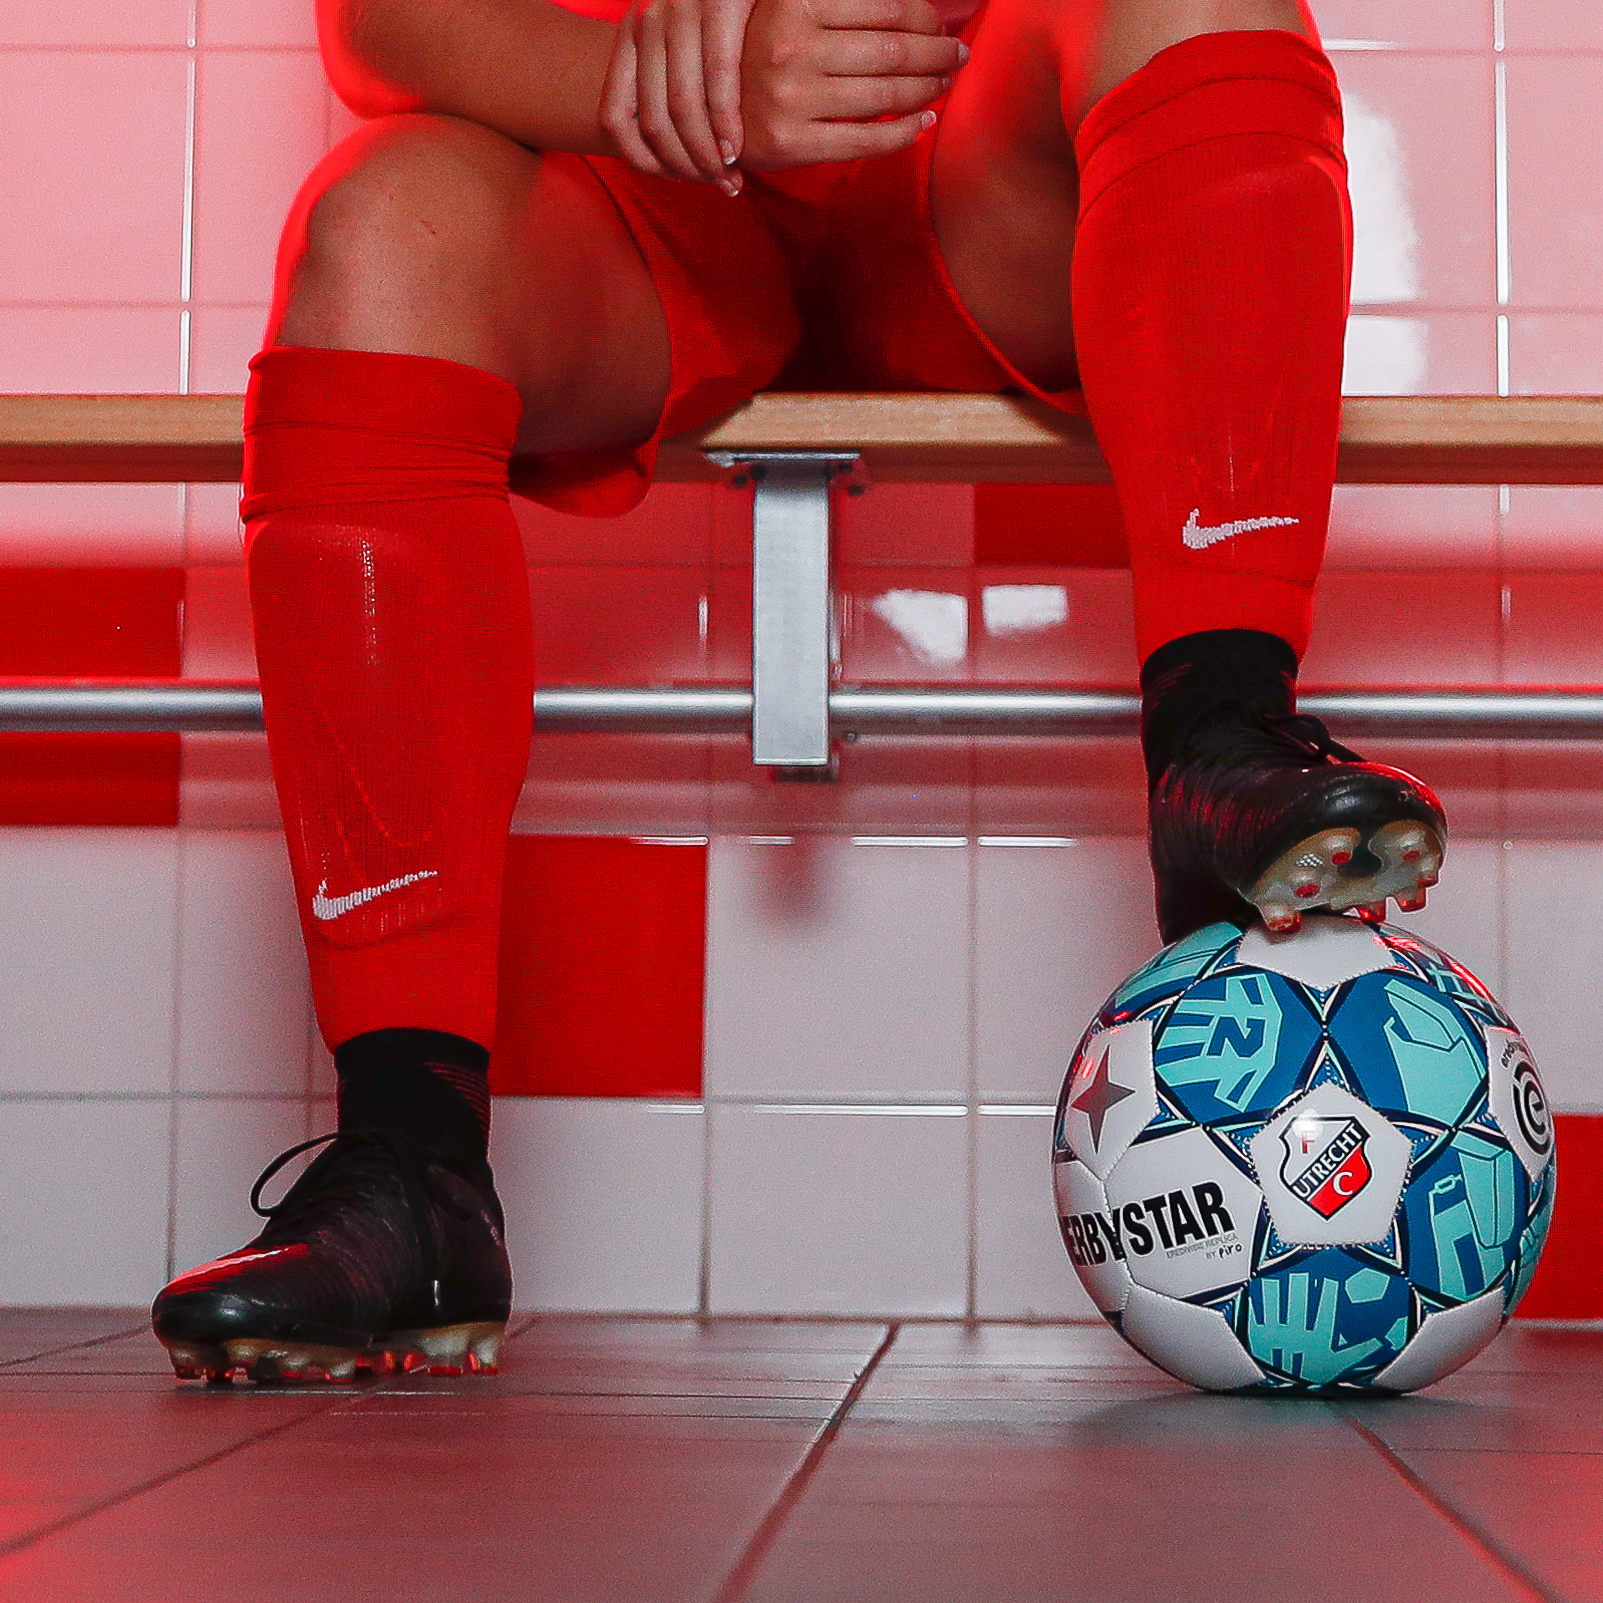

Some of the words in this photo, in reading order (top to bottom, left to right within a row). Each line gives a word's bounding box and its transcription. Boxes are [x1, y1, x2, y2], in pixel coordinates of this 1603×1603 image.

[1292, 1122, 1363, 1198] UTRECHT
[1332, 1170, 1354, 1197] C
[1061, 1181, 1236, 1266] ERBYSTAR
